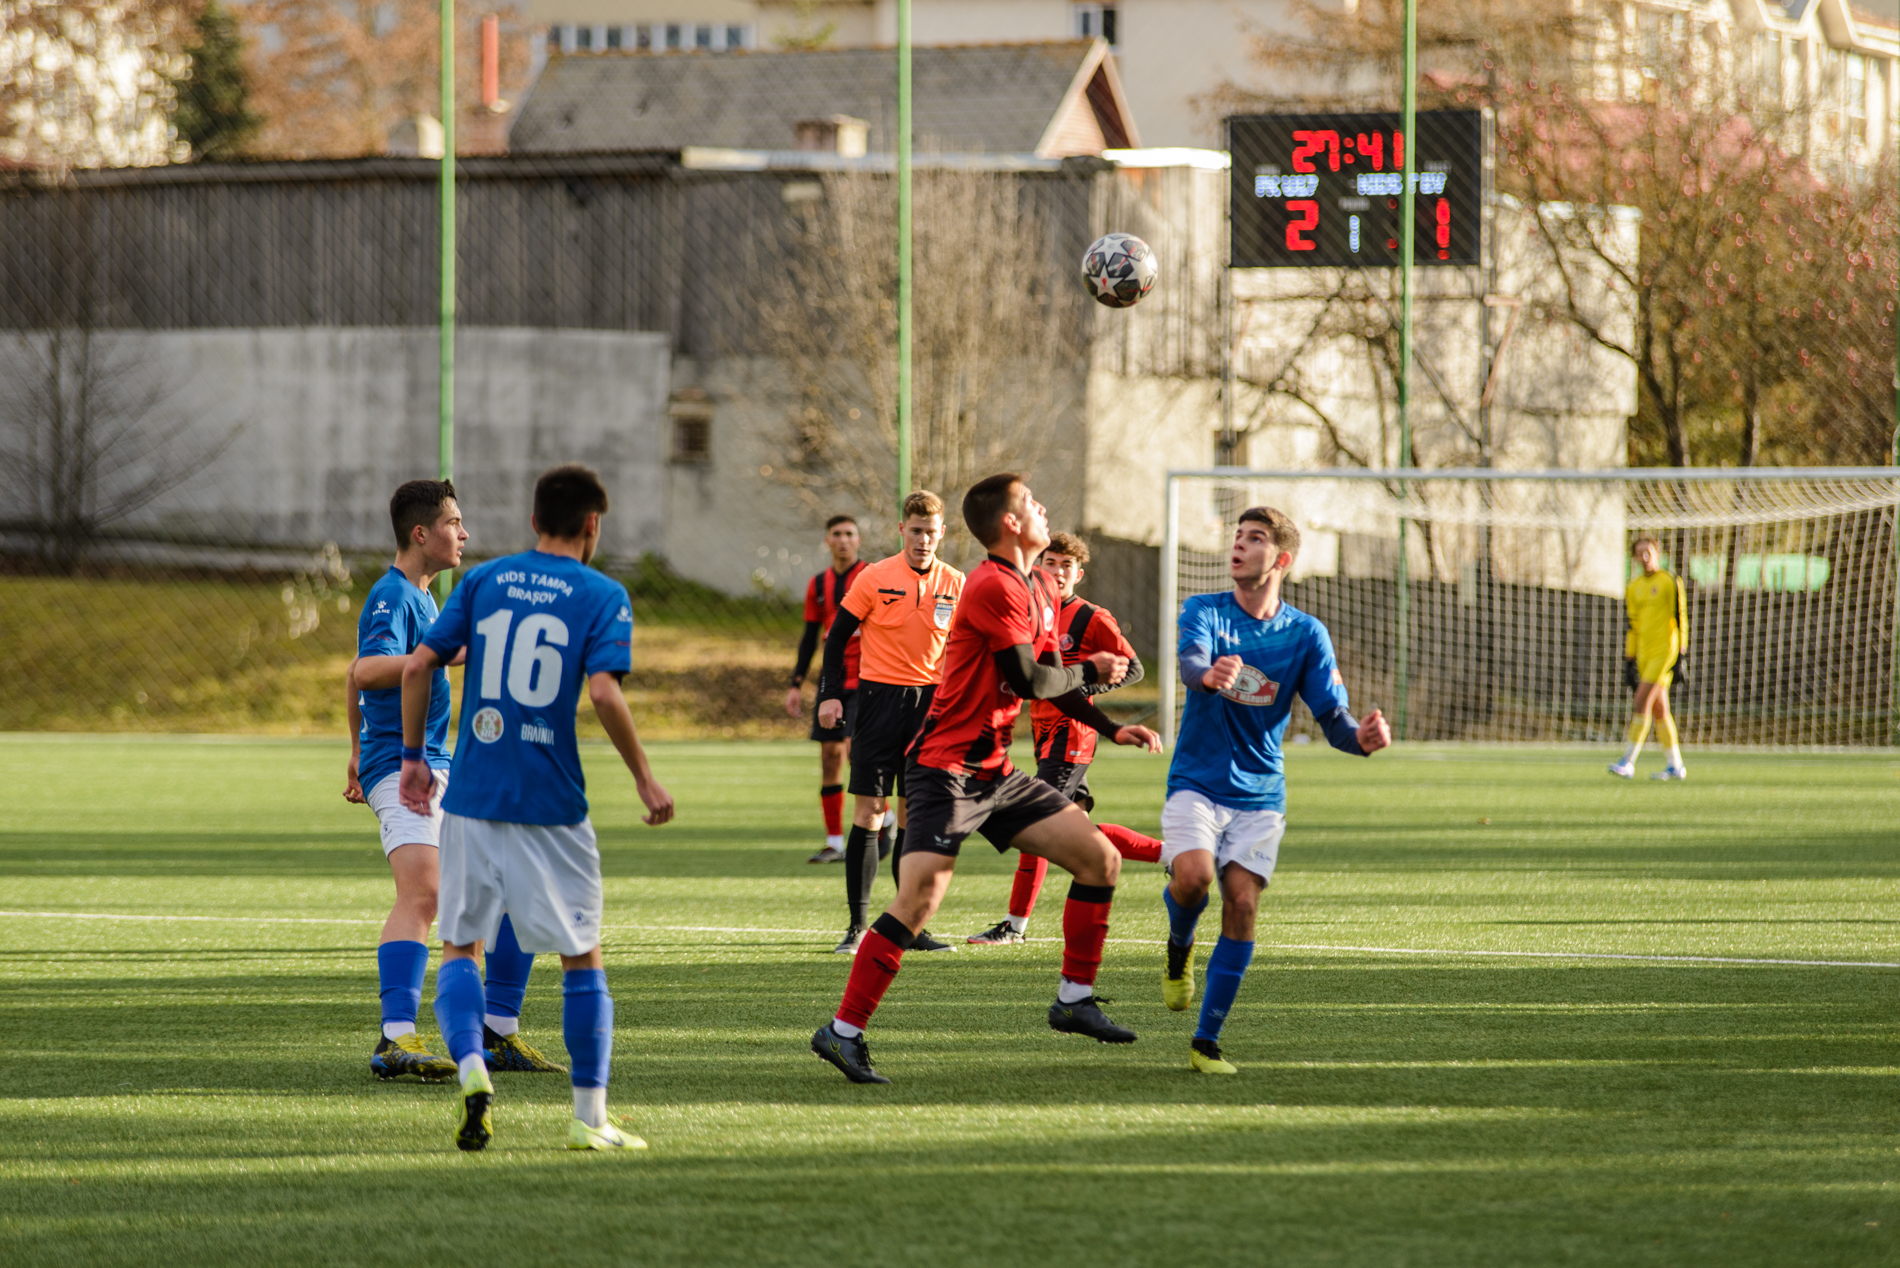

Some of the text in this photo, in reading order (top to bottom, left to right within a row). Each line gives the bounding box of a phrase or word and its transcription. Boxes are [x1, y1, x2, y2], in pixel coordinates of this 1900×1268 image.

[1285, 200, 1319, 251] 2
[496, 570, 573, 597] KIDS TAMPA
[476, 608, 570, 708] 16
